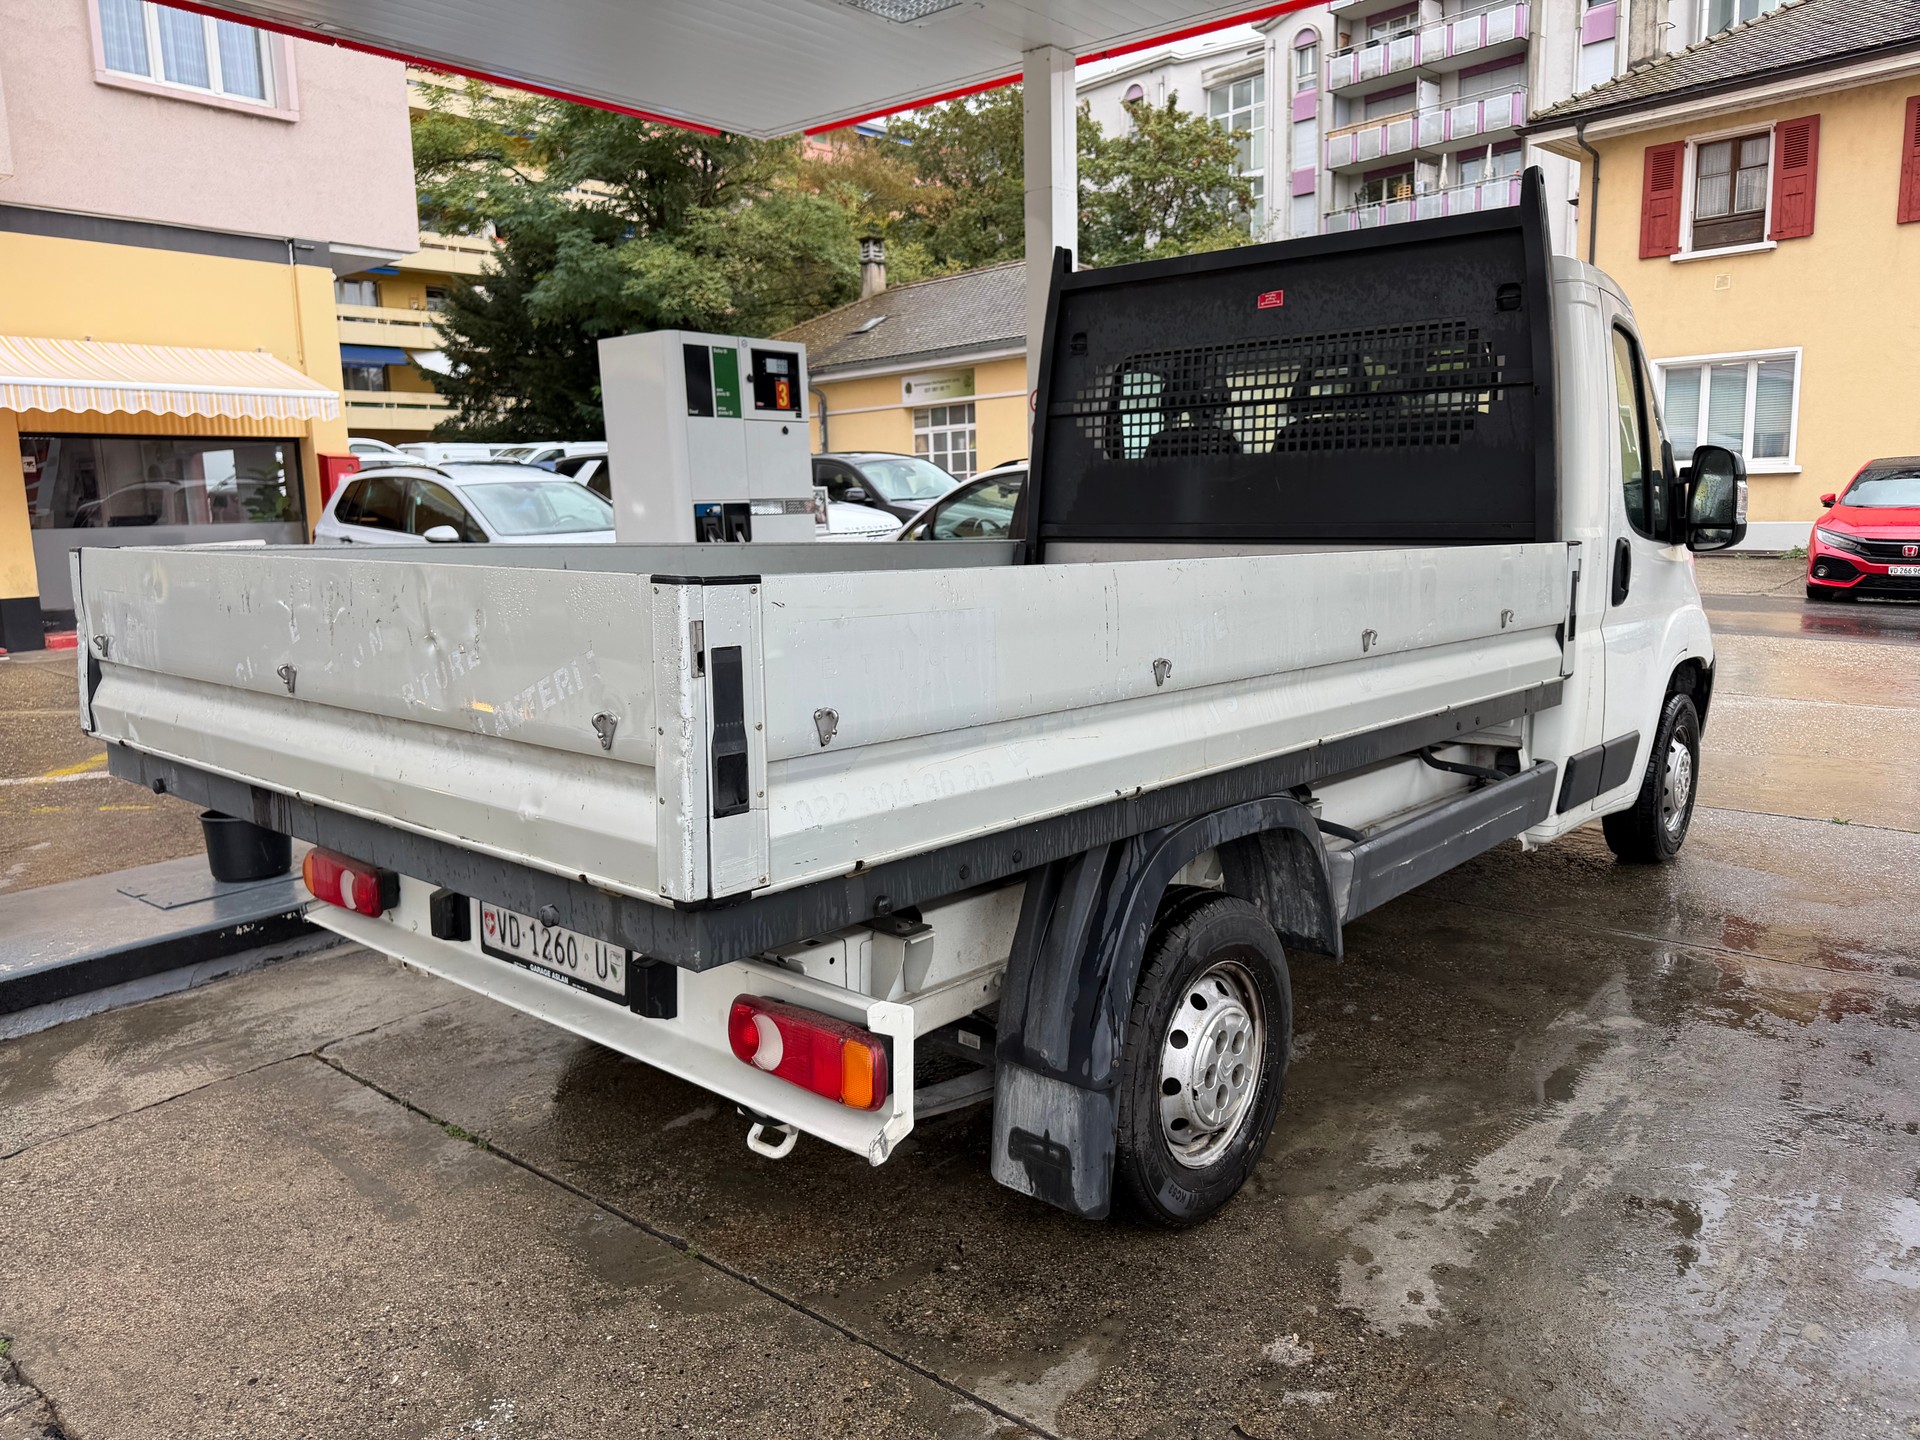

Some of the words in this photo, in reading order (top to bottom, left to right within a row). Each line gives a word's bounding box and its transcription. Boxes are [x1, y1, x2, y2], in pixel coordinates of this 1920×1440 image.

[778, 384, 788, 407] 3
[530, 921, 578, 971] 1260
[595, 941, 608, 980] U
[529, 963, 552, 979] GARAGE
[552, 971, 569, 985] ASLAN
